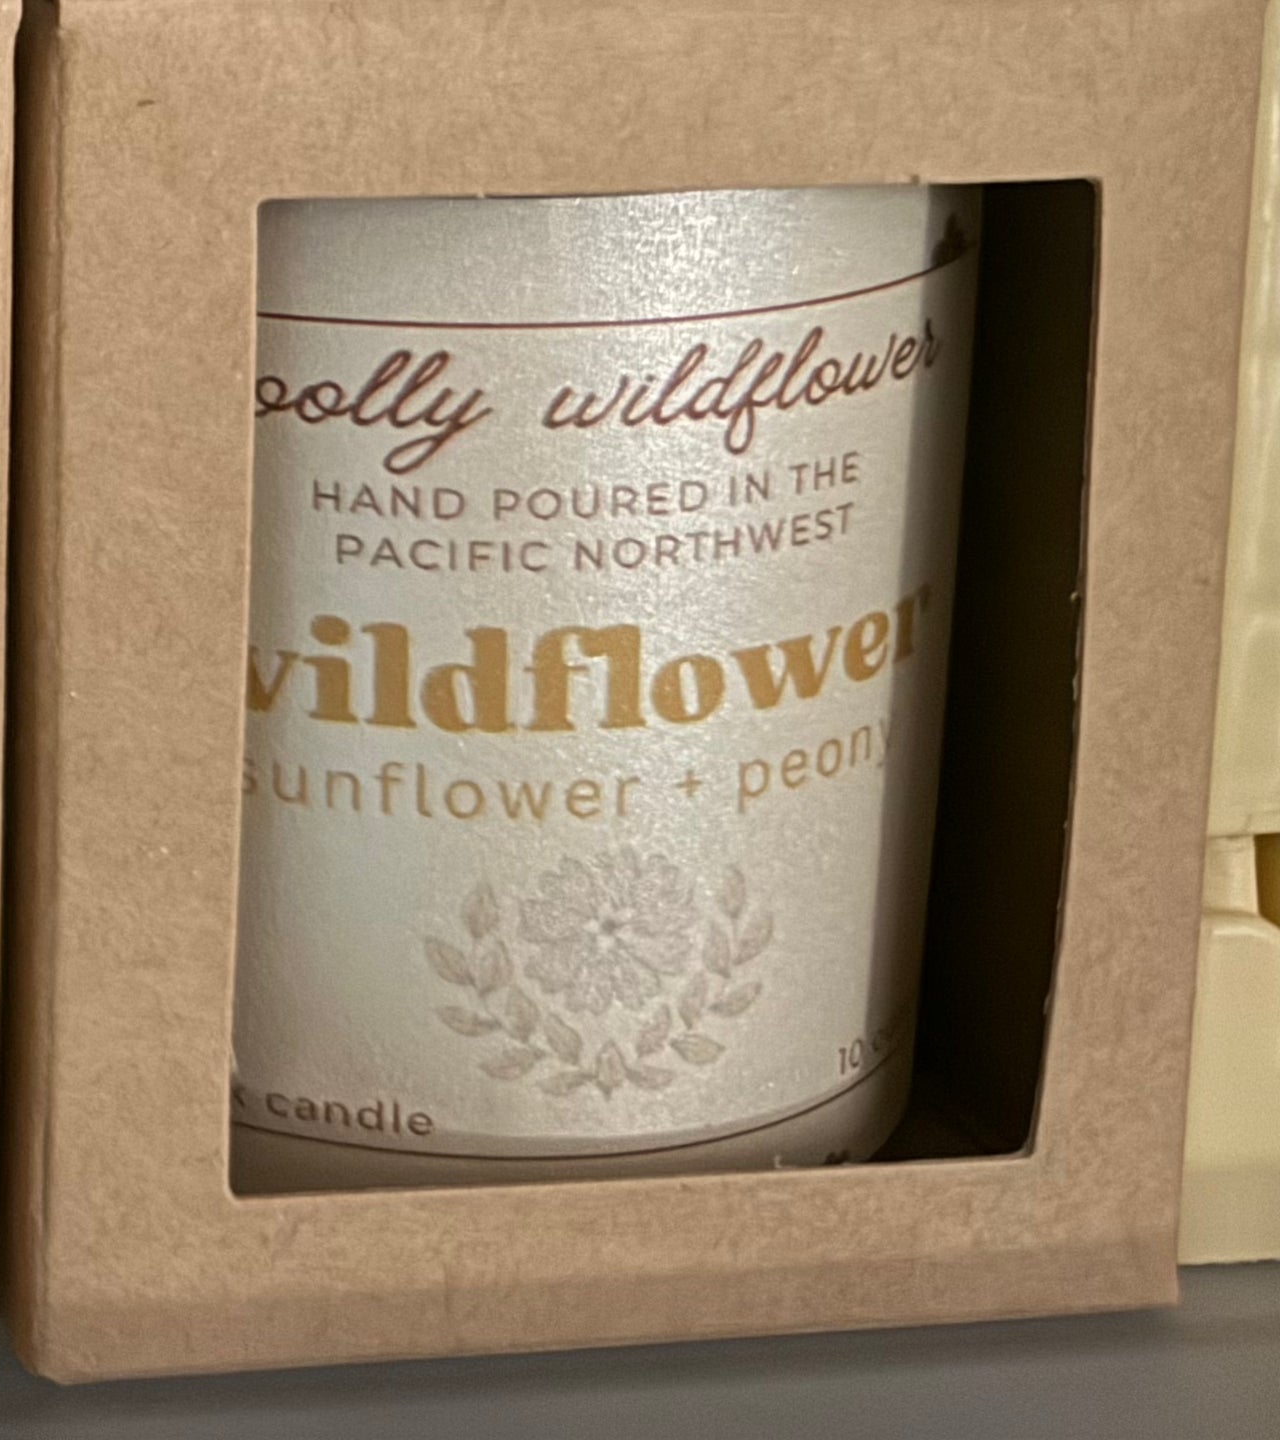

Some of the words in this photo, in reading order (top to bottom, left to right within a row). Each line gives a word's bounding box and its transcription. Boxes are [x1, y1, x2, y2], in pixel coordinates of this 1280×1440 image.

[255, 349, 493, 476] oolly
[541, 325, 942, 457] wildflower
[312, 479, 466, 522] HAND
[492, 480, 709, 523] POURED
[727, 472, 771, 508] IN
[788, 450, 862, 498] THE
[335, 533, 550, 574] PACIFIC
[573, 502, 857, 573] NORTHWEST
[677, 770, 703, 800] +
[736, 720, 893, 814] peony
[837, 1037, 863, 1076] 10
[264, 1091, 435, 1137] candle
